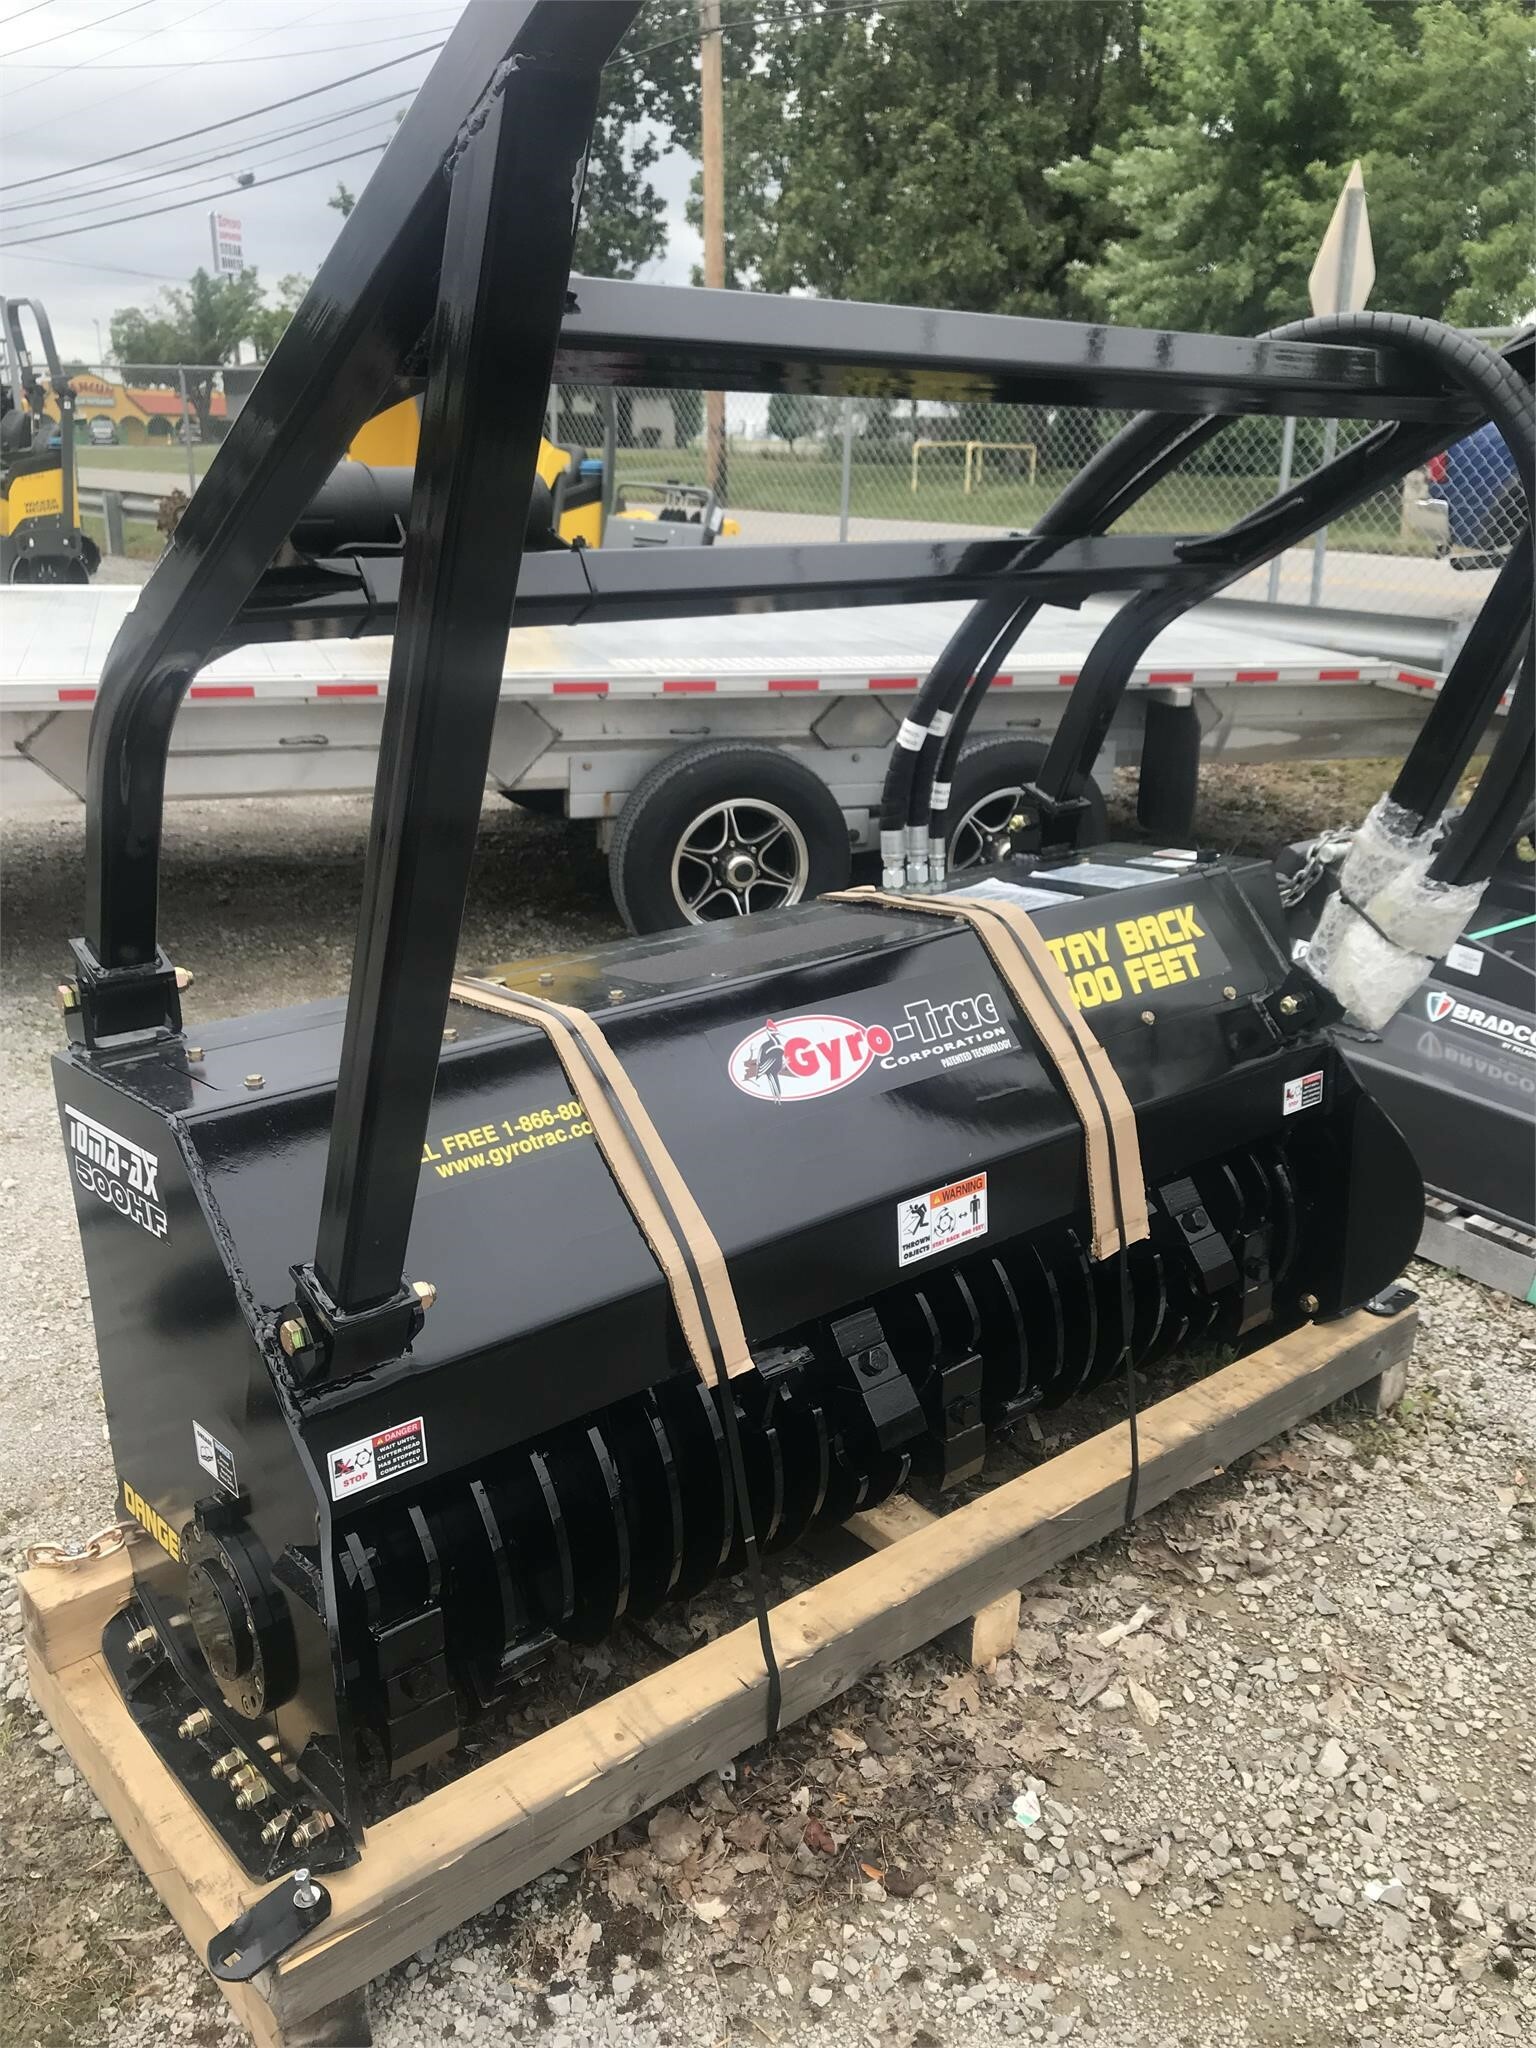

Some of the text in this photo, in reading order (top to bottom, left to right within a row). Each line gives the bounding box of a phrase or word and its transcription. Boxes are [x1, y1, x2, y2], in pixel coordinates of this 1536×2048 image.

[1045, 905, 1206, 973] TAY BACK
[1123, 943, 1200, 994] FEET
[783, 993, 999, 1081] Gyro-Trac
[880, 1026, 1006, 1070] CORPORATION
[940, 1038, 1012, 1069] PATENTED TECHNOLOGY
[435, 1120, 593, 1179] www.gyrotrac.co
[441, 1124, 500, 1155] FREE
[75, 1154, 168, 1238] 500HF
[941, 1178, 983, 1202] WARNING
[902, 1235, 931, 1251] THROWN
[903, 1244, 930, 1260] OBJECTS
[379, 1435, 417, 1453] WAIT UNTIL
[384, 1423, 418, 1441] DANGER
[376, 1441, 421, 1462] CUTTER-HEAD
[378, 1448, 421, 1469] HAS STOPPED
[380, 1455, 421, 1476] COMPLETELY
[343, 1471, 369, 1488] STOP
[123, 1480, 180, 1563] DANGE
